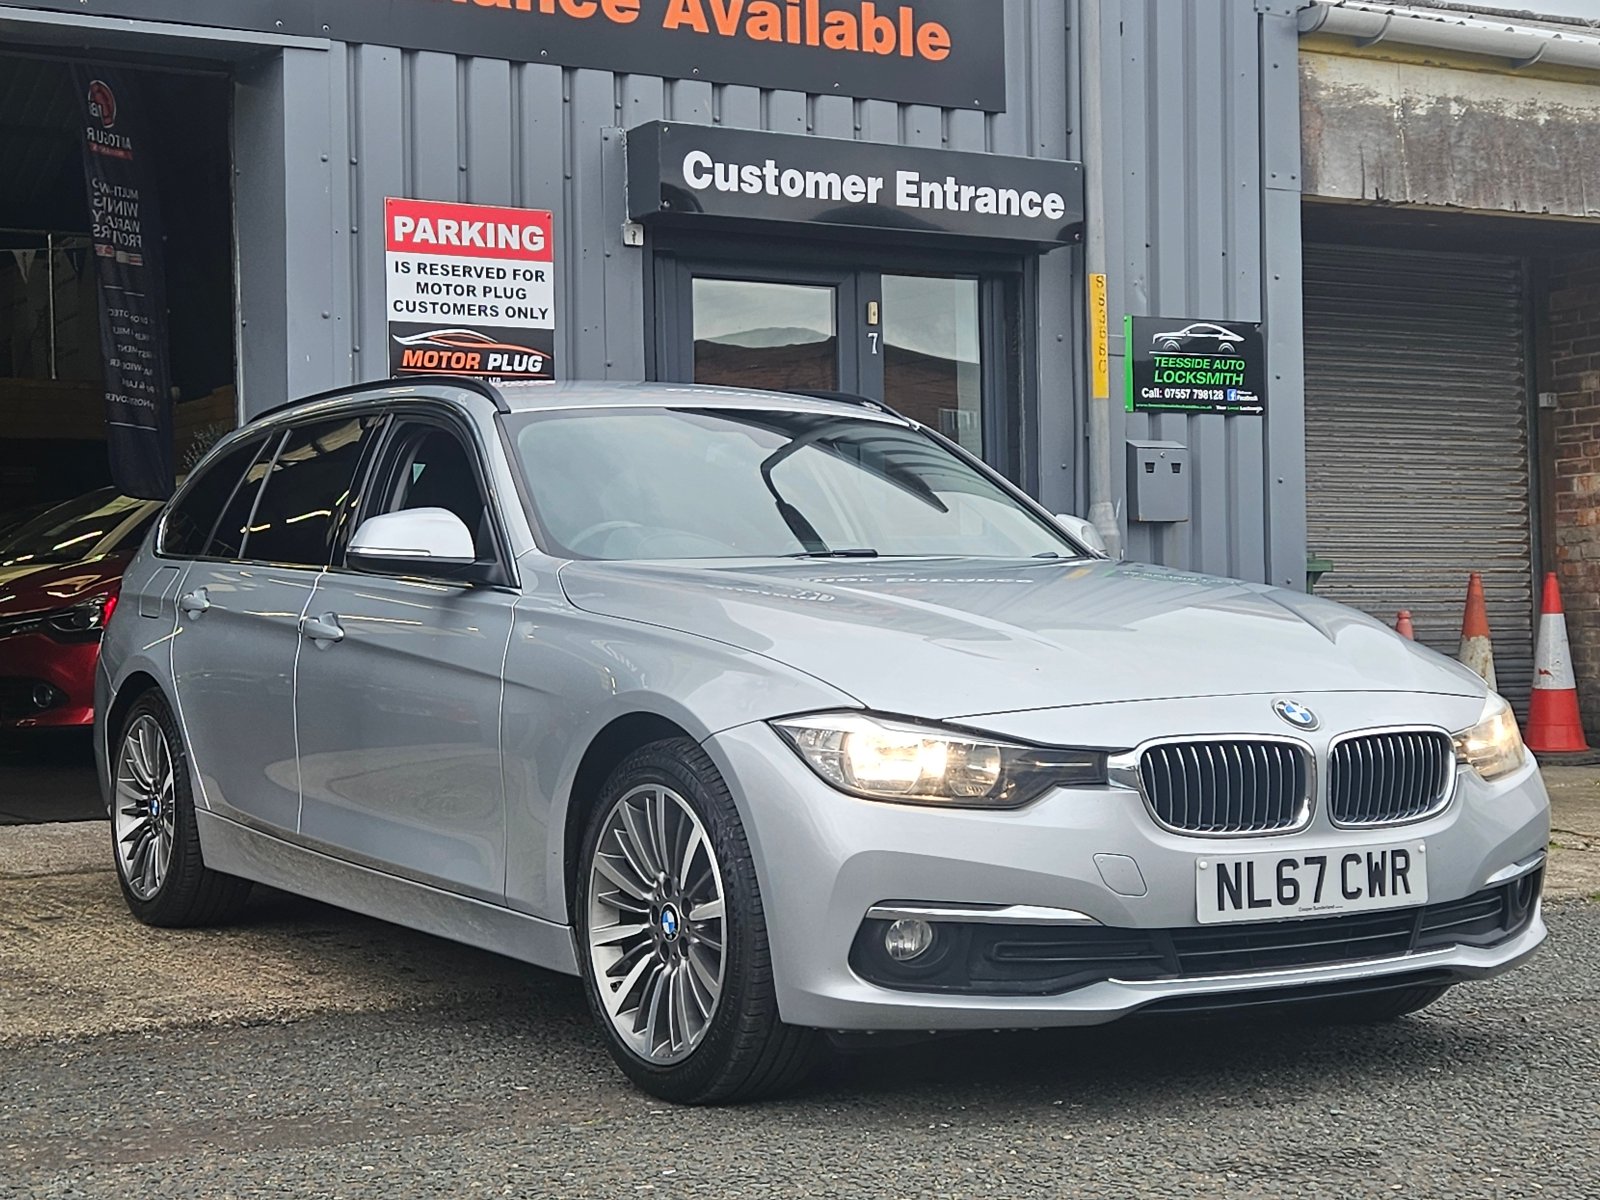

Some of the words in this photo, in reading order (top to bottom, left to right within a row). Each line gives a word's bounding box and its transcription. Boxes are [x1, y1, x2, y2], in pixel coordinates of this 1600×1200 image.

[662, 0, 950, 61] Available
[682, 150, 884, 205] Customer
[896, 170, 1066, 220] Entrance
[393, 215, 545, 251] PARKING
[395, 260, 411, 273] IS
[416, 262, 507, 280] RESERVED
[512, 268, 545, 282] FOR
[416, 281, 478, 297] MOTOR
[482, 285, 527, 300] PLUG
[392, 299, 500, 317] CUSTOMERS
[504, 305, 549, 320] ONLY
[868, 333, 878, 354] 7
[402, 349, 481, 370] MOTOR
[487, 353, 544, 372] PLUG
[1154, 357, 1211, 369] TEESSIDE
[1213, 360, 1245, 370] AUTO
[1154, 370, 1243, 385] LOCKSMITH
[1141, 387, 1163, 398] Call:
[1164, 388, 1190, 399] 07557
[1193, 389, 1224, 400] 798128
[1216, 855, 1327, 911] NL67
[1340, 848, 1411, 901] CWR
